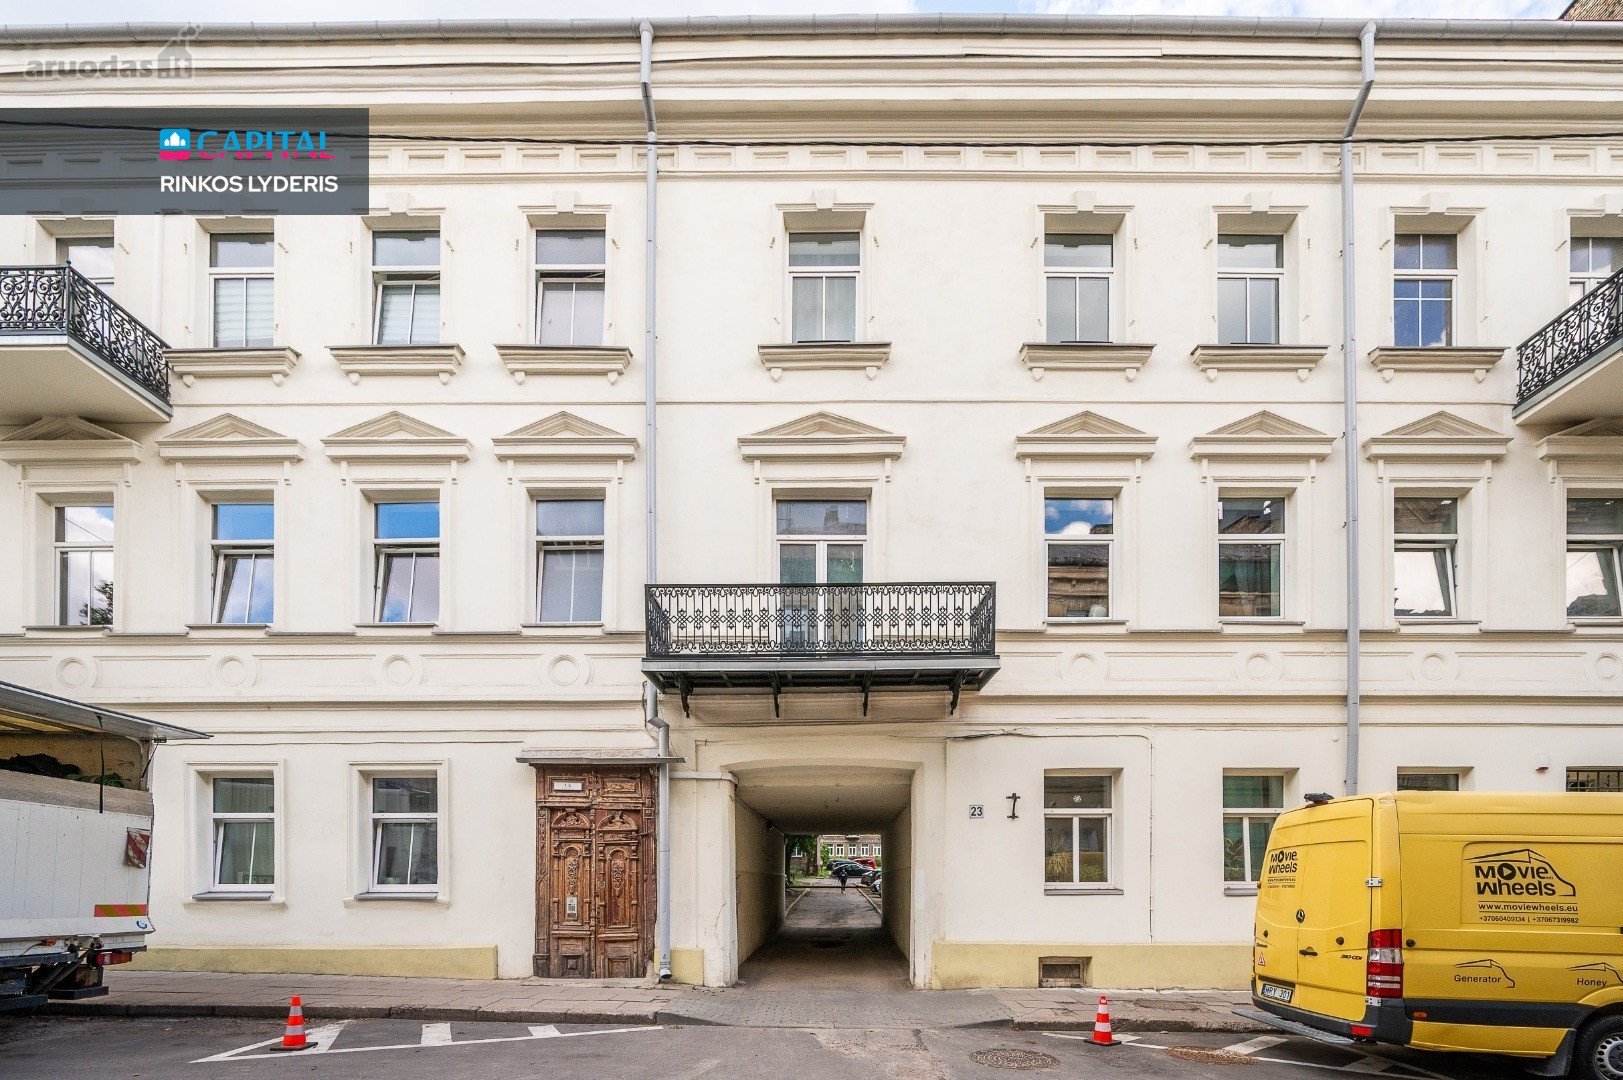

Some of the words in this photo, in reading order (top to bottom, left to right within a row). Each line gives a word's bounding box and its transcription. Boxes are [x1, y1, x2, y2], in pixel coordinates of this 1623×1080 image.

[970, 806, 983, 817] 23
[1478, 903, 1579, 913] www.moviewheels.eu
[1453, 974, 1502, 984] Generator
[1576, 977, 1608, 988] Honey
